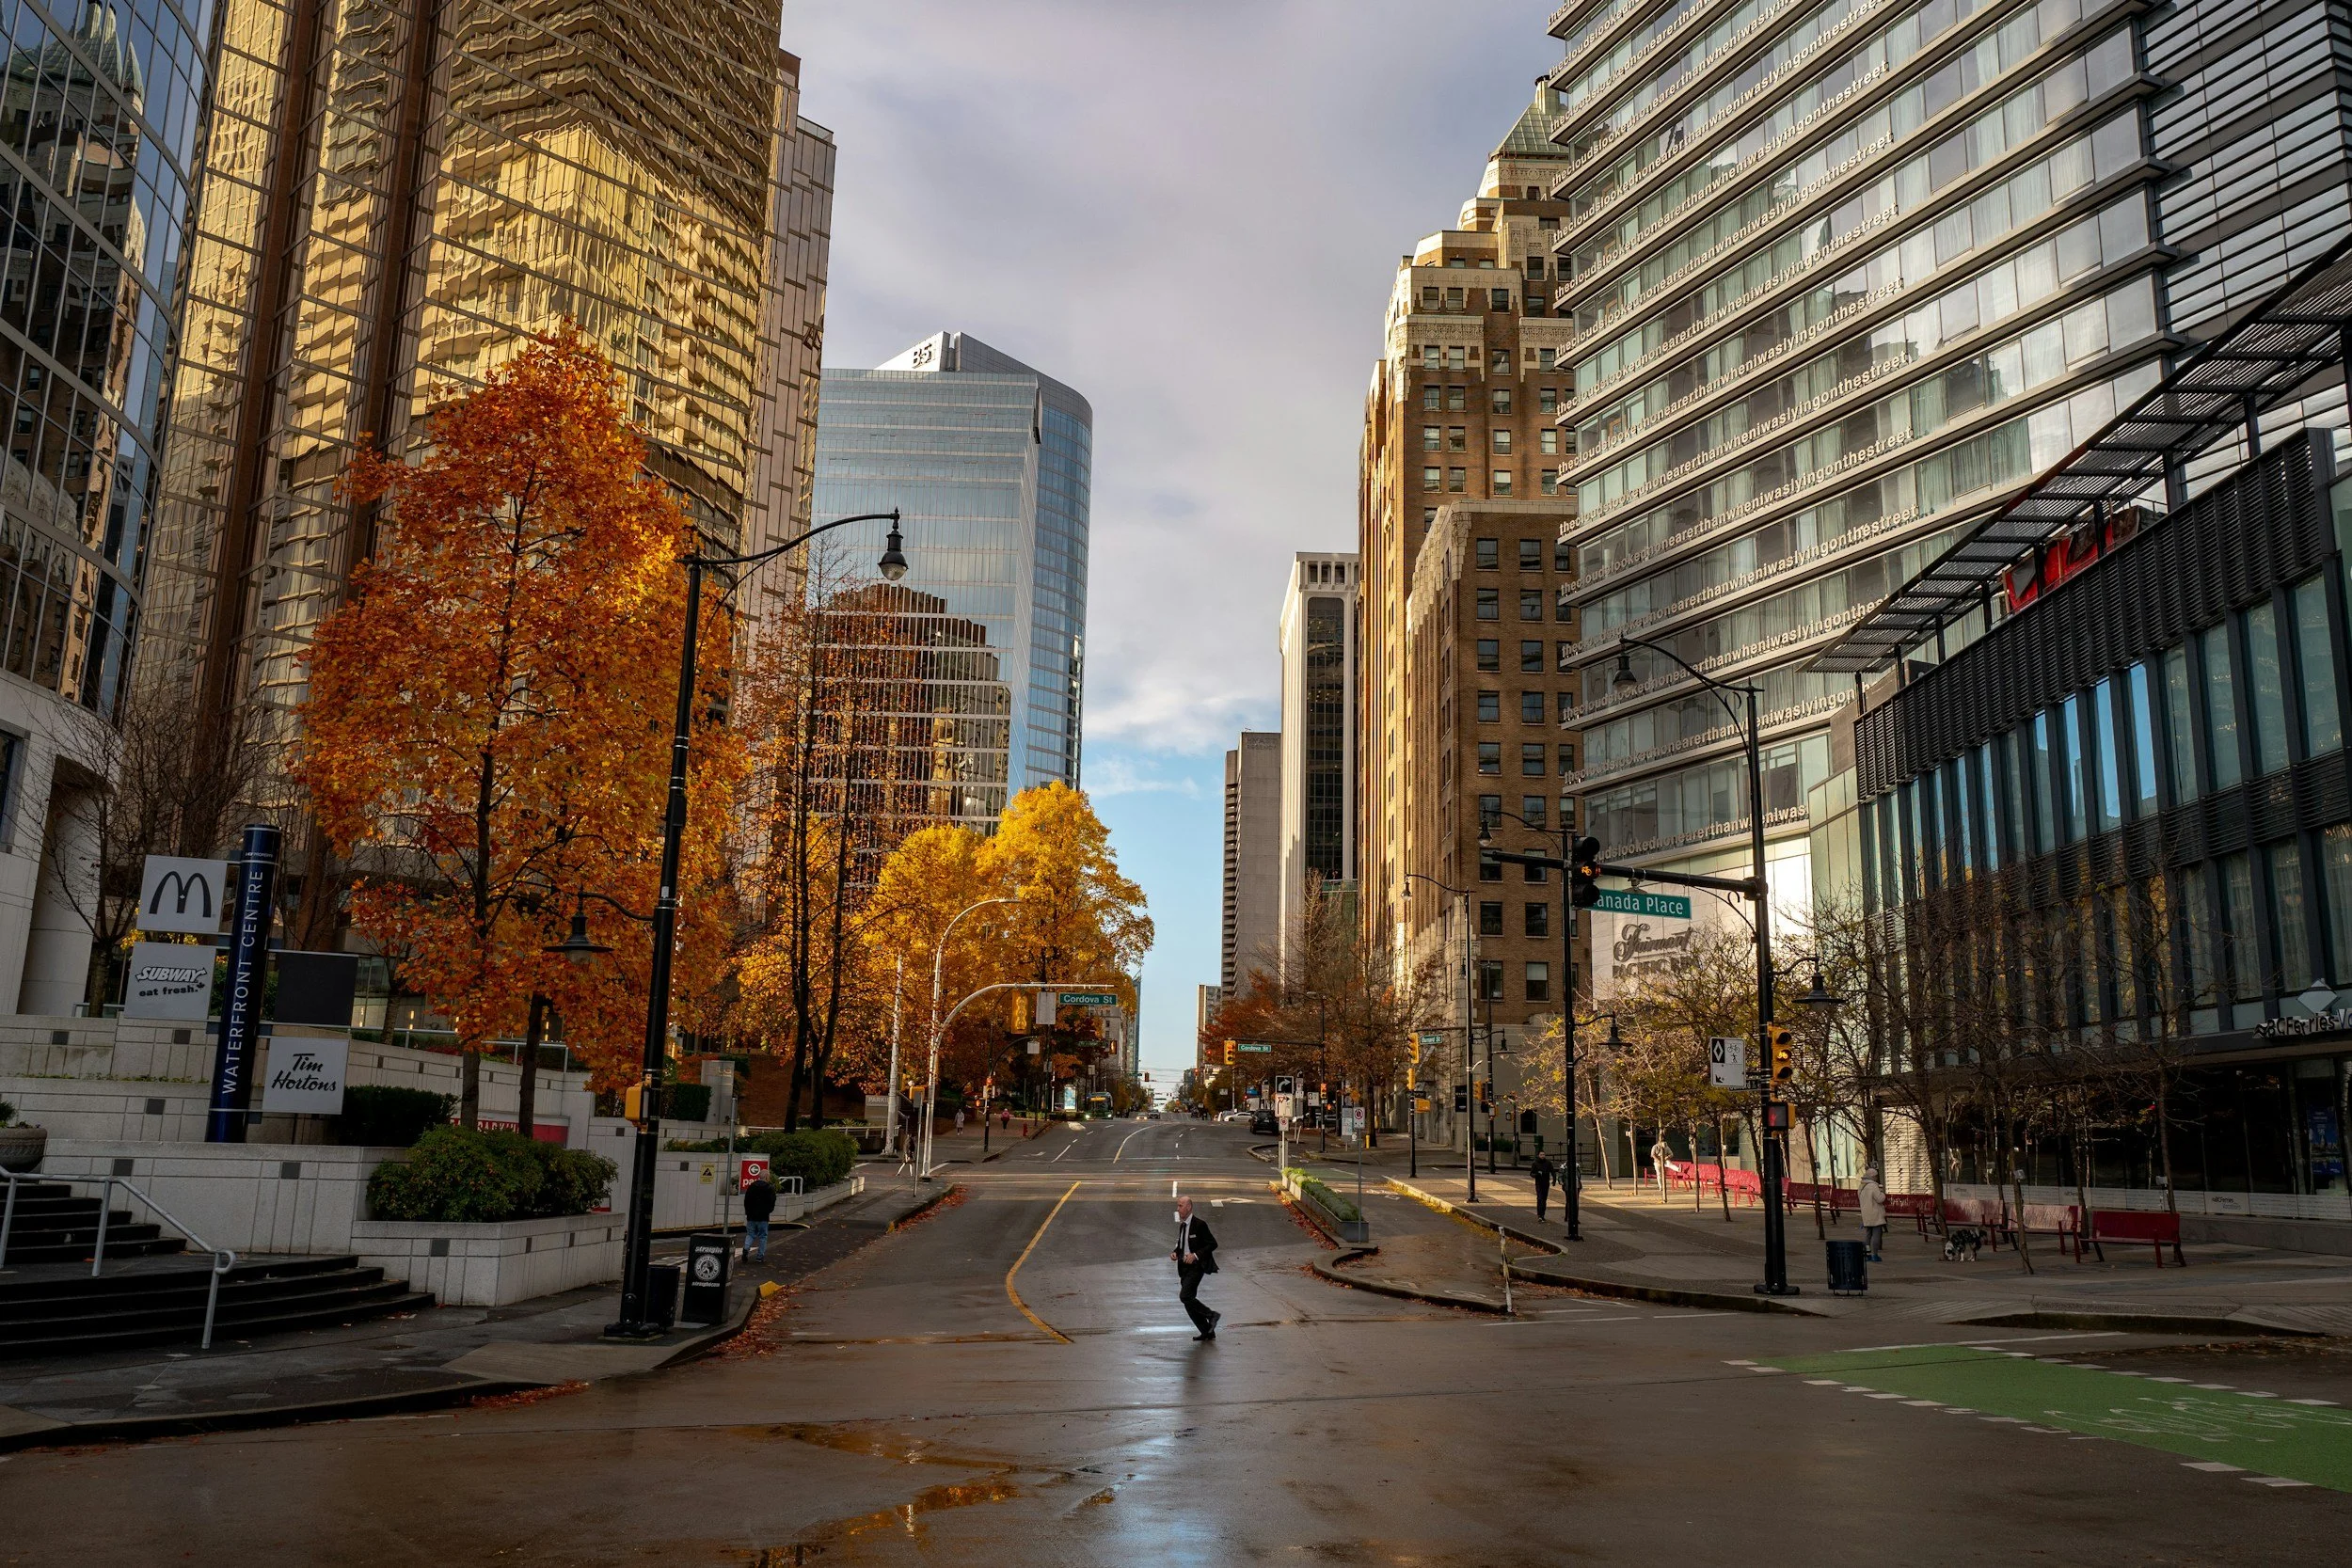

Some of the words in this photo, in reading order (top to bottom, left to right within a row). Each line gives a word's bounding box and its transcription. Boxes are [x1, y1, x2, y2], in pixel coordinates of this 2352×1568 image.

[1594, 895, 1640, 911] anada
[1645, 896, 1684, 914] Place
[135, 966, 207, 983] SUBWAY
[222, 959, 252, 1094] WATERFRONT
[243, 870, 263, 948] CENTRE
[138, 988, 159, 997] eat
[1063, 994, 1100, 1003] Cordova
[1103, 995, 1113, 1004] St
[293, 1053, 324, 1072] Tim
[271, 1070, 337, 1092] Hortons
